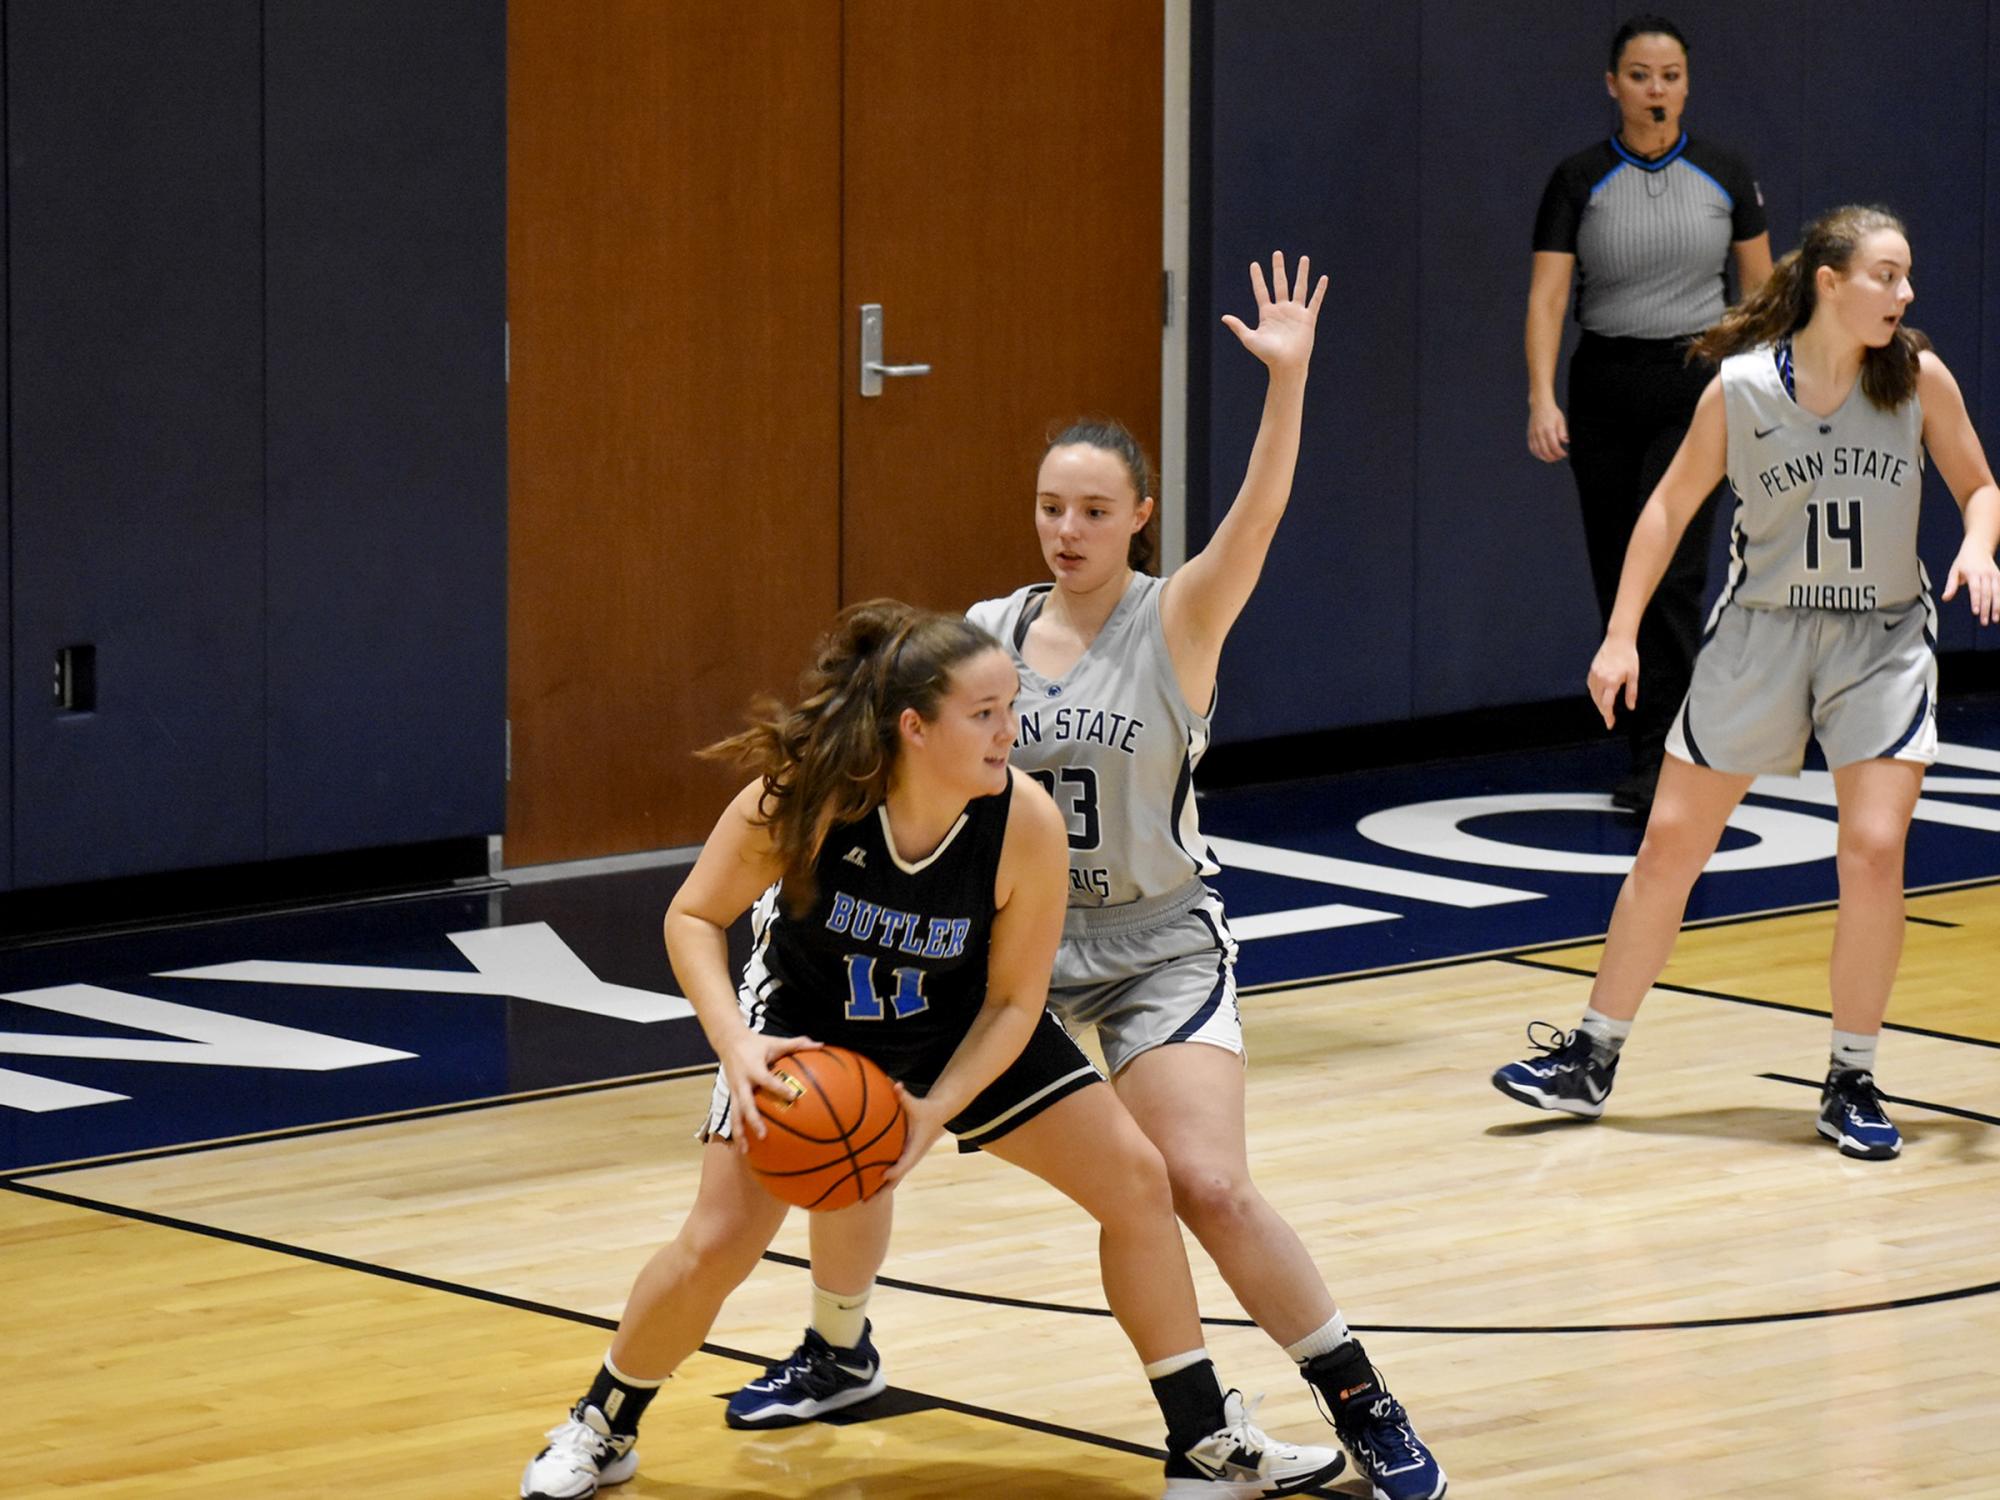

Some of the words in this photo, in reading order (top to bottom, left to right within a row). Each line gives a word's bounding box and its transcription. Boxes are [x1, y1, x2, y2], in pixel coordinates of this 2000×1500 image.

[1759, 451, 1824, 498] PENN
[1833, 447, 1909, 487] STATE
[1804, 498, 1865, 573] 14
[1789, 584, 1876, 610] DUBOIS
[1055, 707, 1145, 754] STATE
[826, 891, 971, 959] BUTLER
[843, 953, 930, 1020] 11
